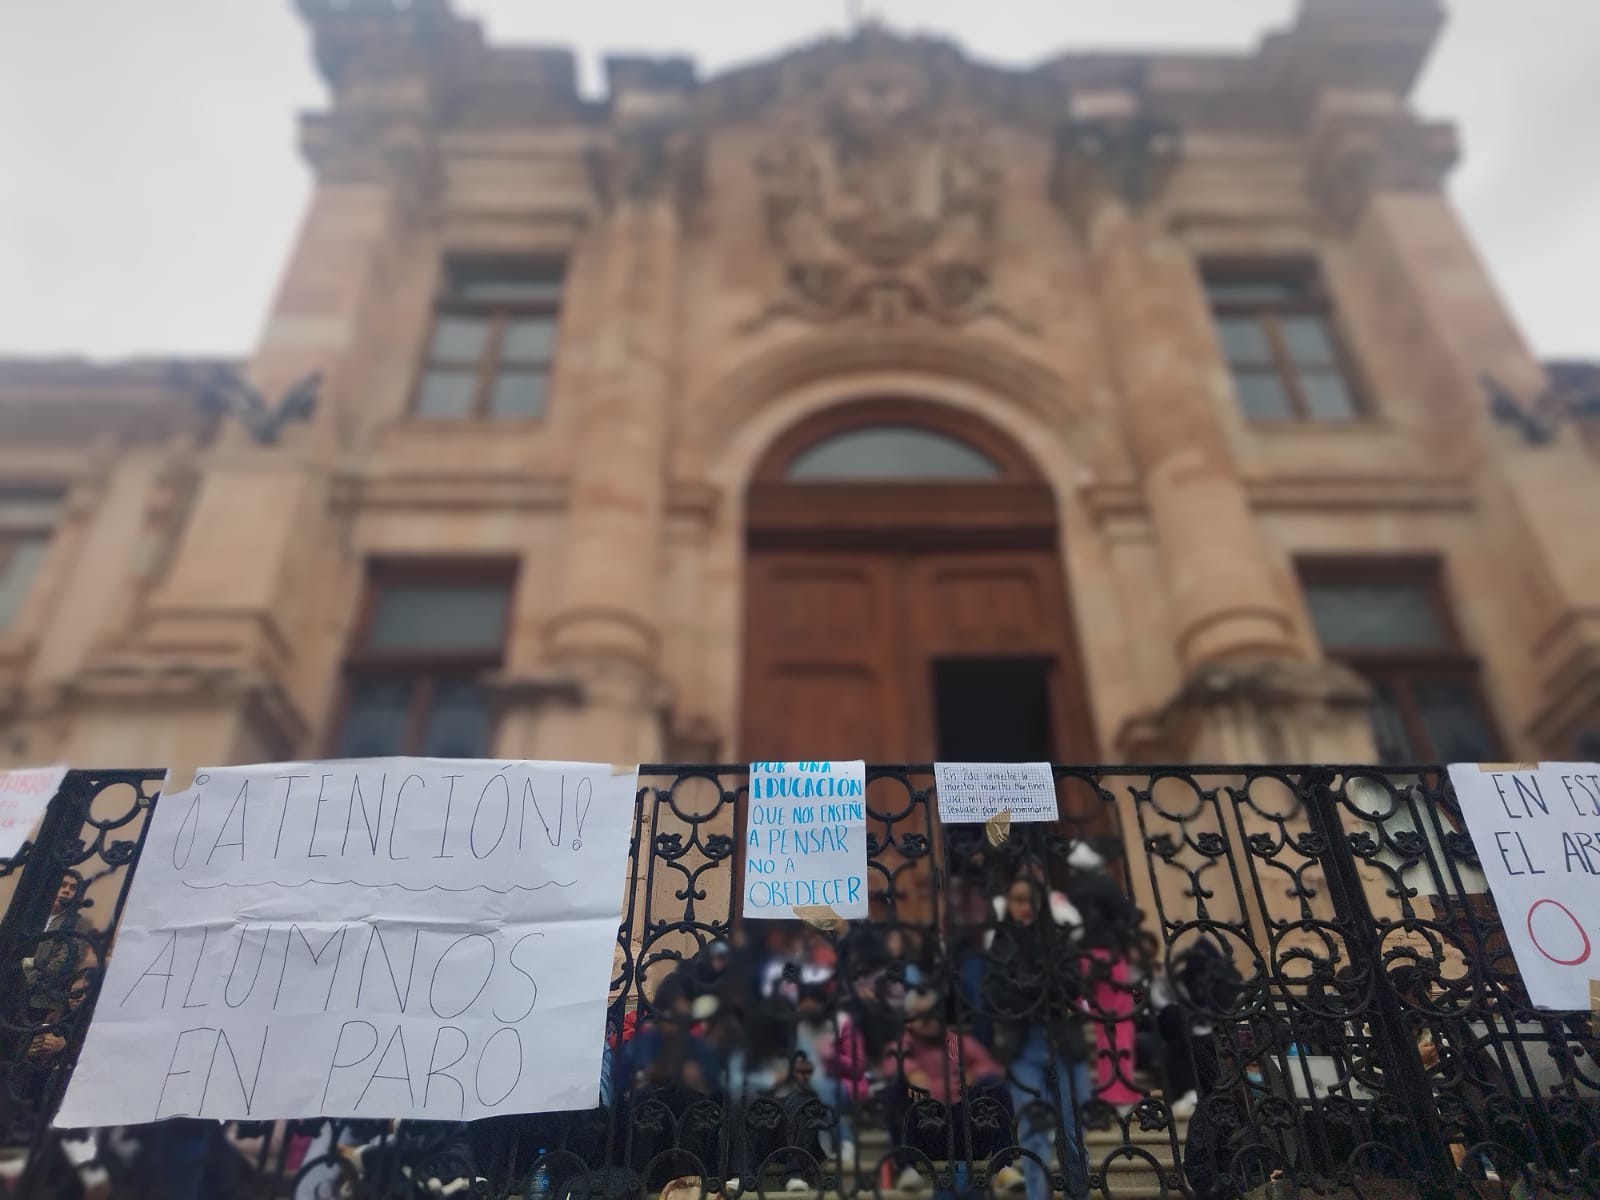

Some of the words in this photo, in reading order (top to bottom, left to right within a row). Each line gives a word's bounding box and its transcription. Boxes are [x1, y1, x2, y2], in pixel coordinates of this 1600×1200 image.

[753, 761, 785, 774] POR
[799, 761, 831, 774] UNA
[752, 805, 785, 826] QUE
[792, 806, 814, 824] NOS
[820, 800, 865, 823] ENSEÑE
[1491, 774, 1549, 818] EN
[172, 764, 593, 870] ¡ATENCIÓN!
[749, 829, 759, 848] A
[769, 824, 849, 855] PENSAR
[1494, 832, 1546, 876] EL
[749, 859, 775, 874] NO
[785, 858, 795, 873] A
[750, 876, 861, 908] OBEDECER
[120, 923, 545, 1024] ALUMNOS
[155, 1024, 269, 1120] EN
[321, 1021, 523, 1114] PARO
